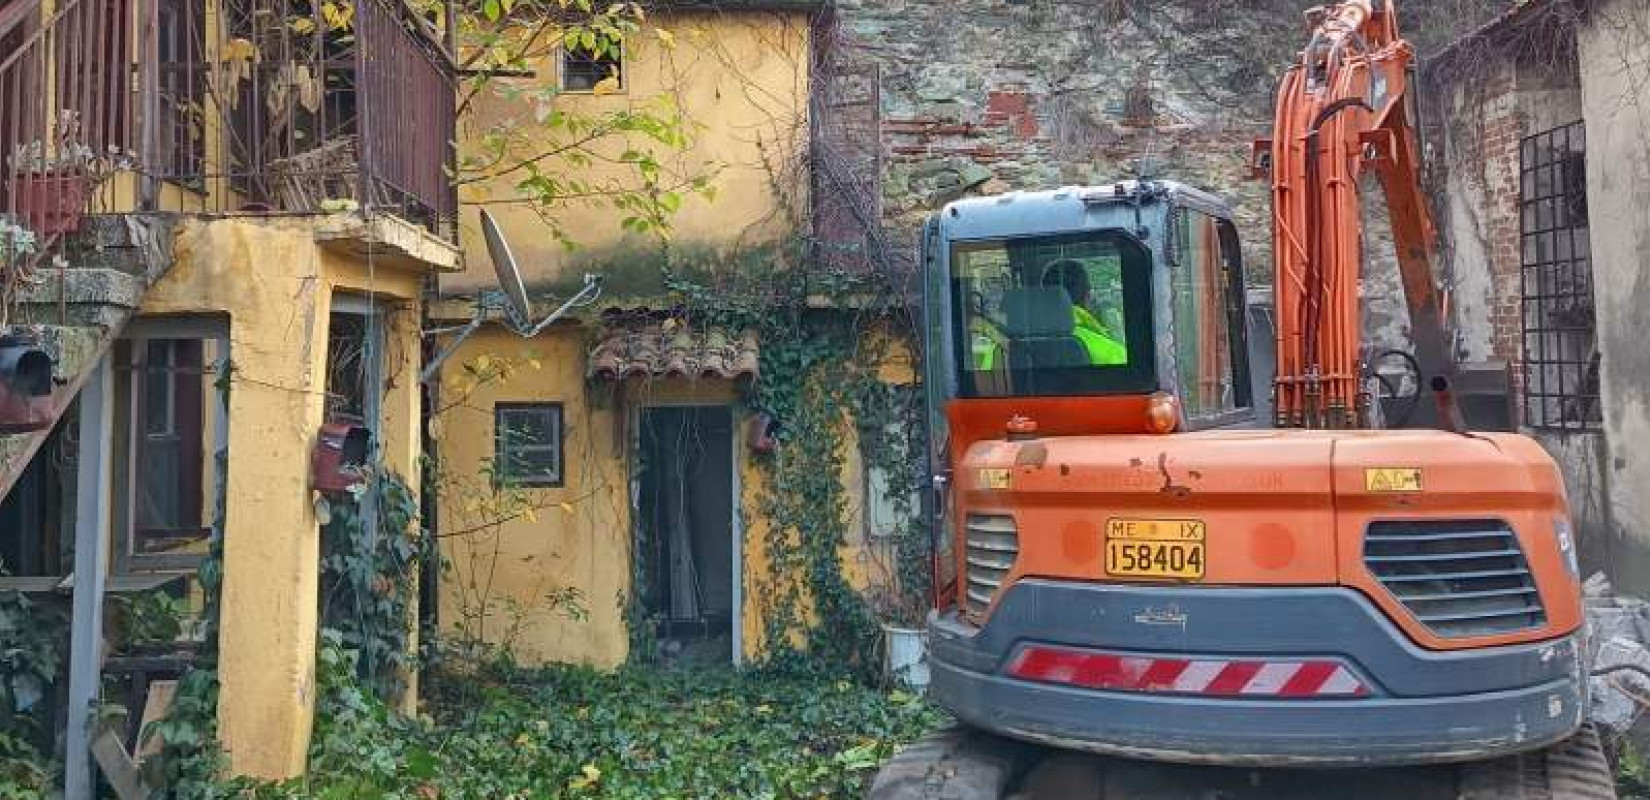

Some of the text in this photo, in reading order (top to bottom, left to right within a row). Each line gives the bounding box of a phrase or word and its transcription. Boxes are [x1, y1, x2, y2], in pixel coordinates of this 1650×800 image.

[1112, 522, 1198, 538] ME IX
[1111, 544, 1201, 574] 158404
